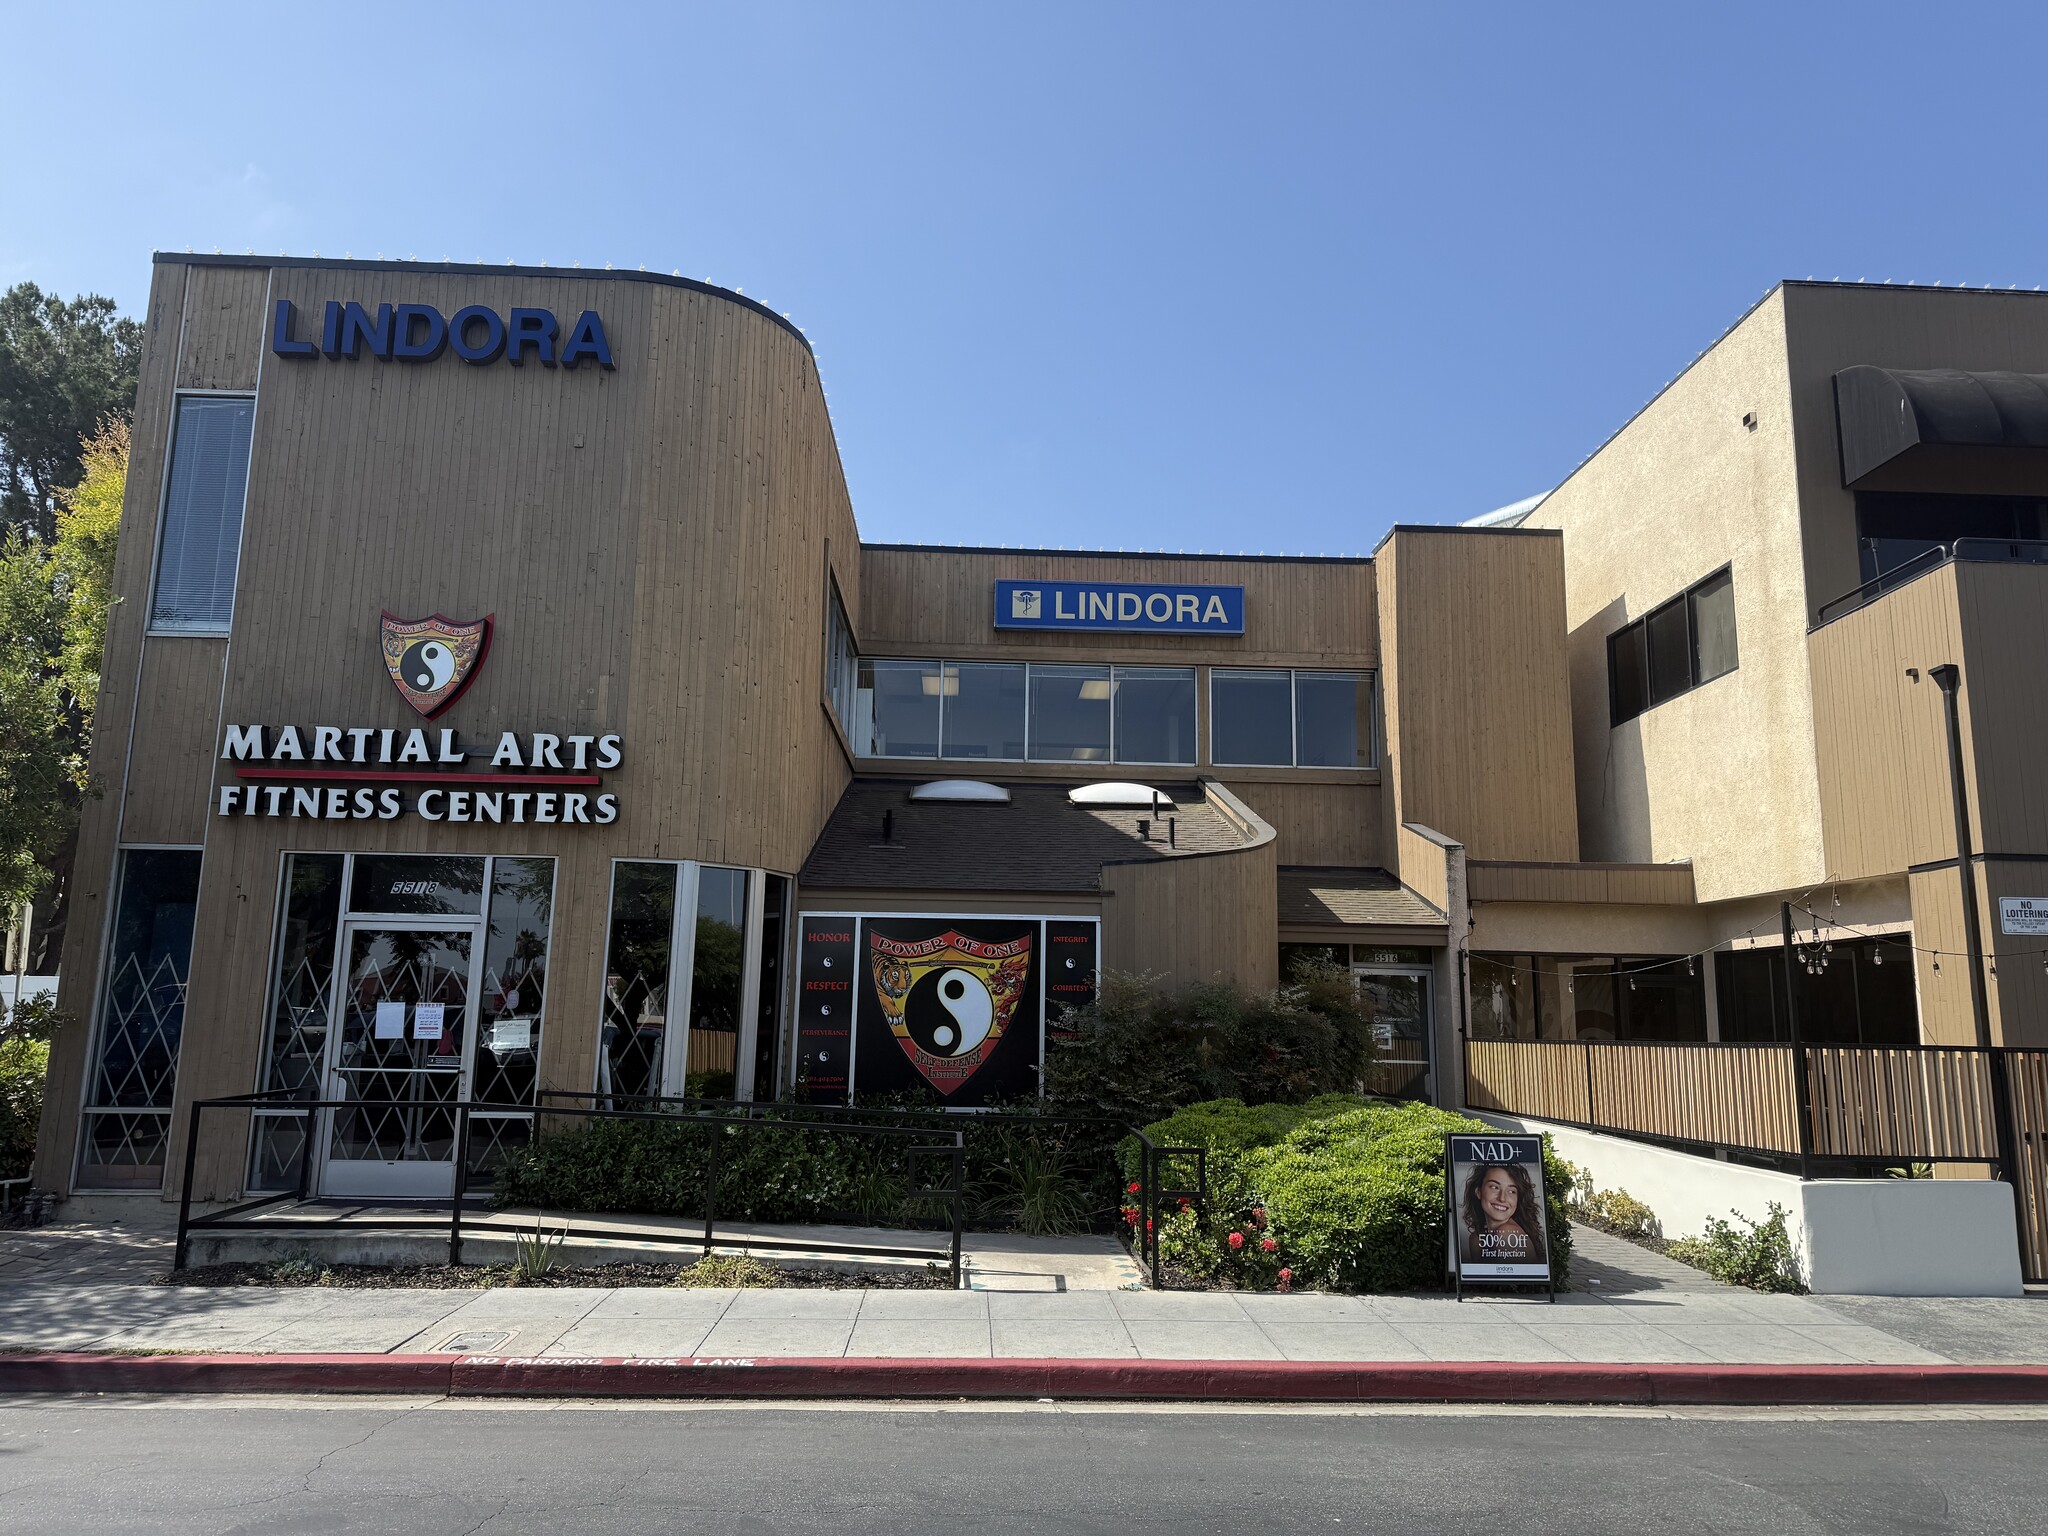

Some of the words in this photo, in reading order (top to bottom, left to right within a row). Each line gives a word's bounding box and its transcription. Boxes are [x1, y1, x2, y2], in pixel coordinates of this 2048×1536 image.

[272, 300, 616, 370] LINDORA
[1055, 591, 1229, 624] LINDORA
[386, 622, 428, 634] POWER
[434, 623, 449, 632] OF
[220, 724, 468, 763] MARTIAL
[490, 731, 624, 770] ARTS
[218, 785, 403, 819] FITNESS
[417, 789, 620, 825] CENTERS
[391, 882, 439, 894] 5518
[2020, 901, 2032, 909] NO
[2006, 909, 2048, 918] LOITERING
[808, 932, 850, 943] HONOR
[878, 937, 947, 955] POWER
[954, 937, 980, 951] OF
[982, 940, 1023, 957] ONE
[1375, 954, 1398, 962] 5516
[806, 981, 849, 991] RESPECT
[1052, 984, 1089, 992] COURTESY
[915, 1047, 983, 1067] SELF-DEFENSE
[1469, 1141, 1523, 1161] NAD+
[1478, 1233, 1506, 1248] 50%
[1507, 1233, 1529, 1248] Off
[1481, 1249, 1497, 1257] First
[1497, 1249, 1526, 1259] Injection
[464, 1356, 500, 1365] NO
[505, 1356, 604, 1366] PARKING
[621, 1357, 680, 1366] FIRE
[692, 1358, 757, 1367] LANE
